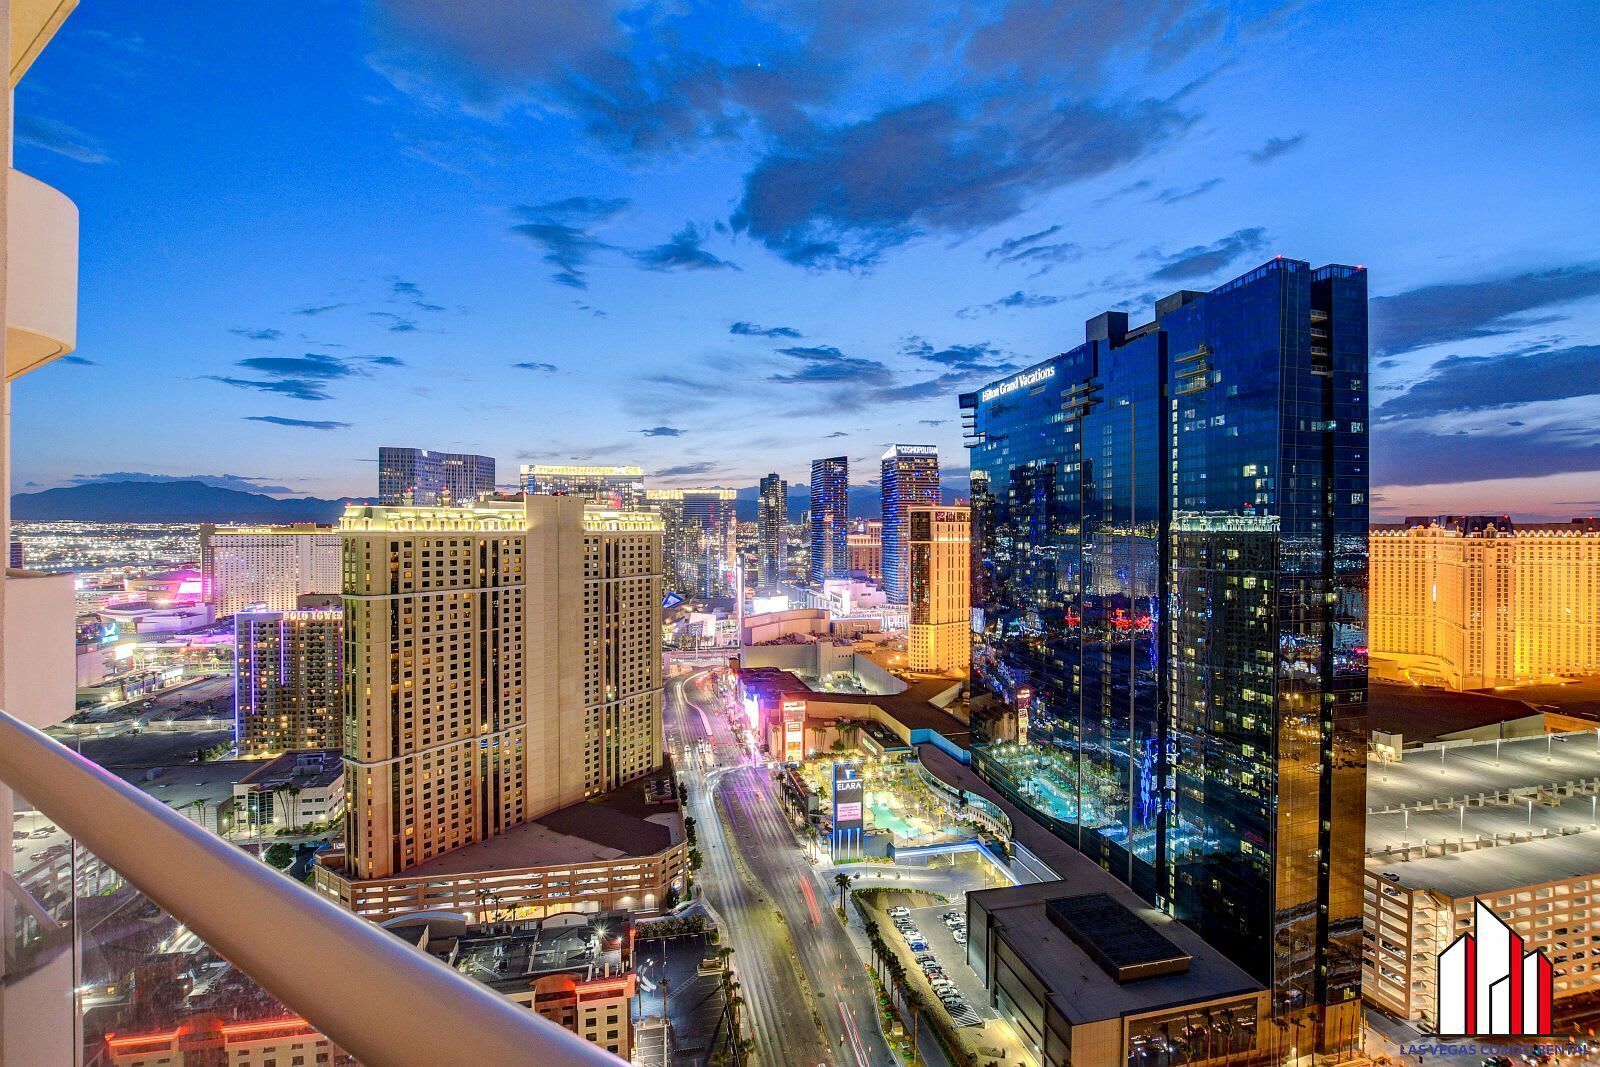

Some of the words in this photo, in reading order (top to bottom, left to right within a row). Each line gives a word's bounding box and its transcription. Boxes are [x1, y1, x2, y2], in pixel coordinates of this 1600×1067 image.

[982, 388, 1000, 402] Hilton
[1000, 377, 1018, 395] Grand
[1019, 366, 1055, 387] Vacations
[901, 446, 938, 454] COSMOPOLITAN
[283, 611, 308, 620] POLO
[837, 782, 862, 791] ELARA
